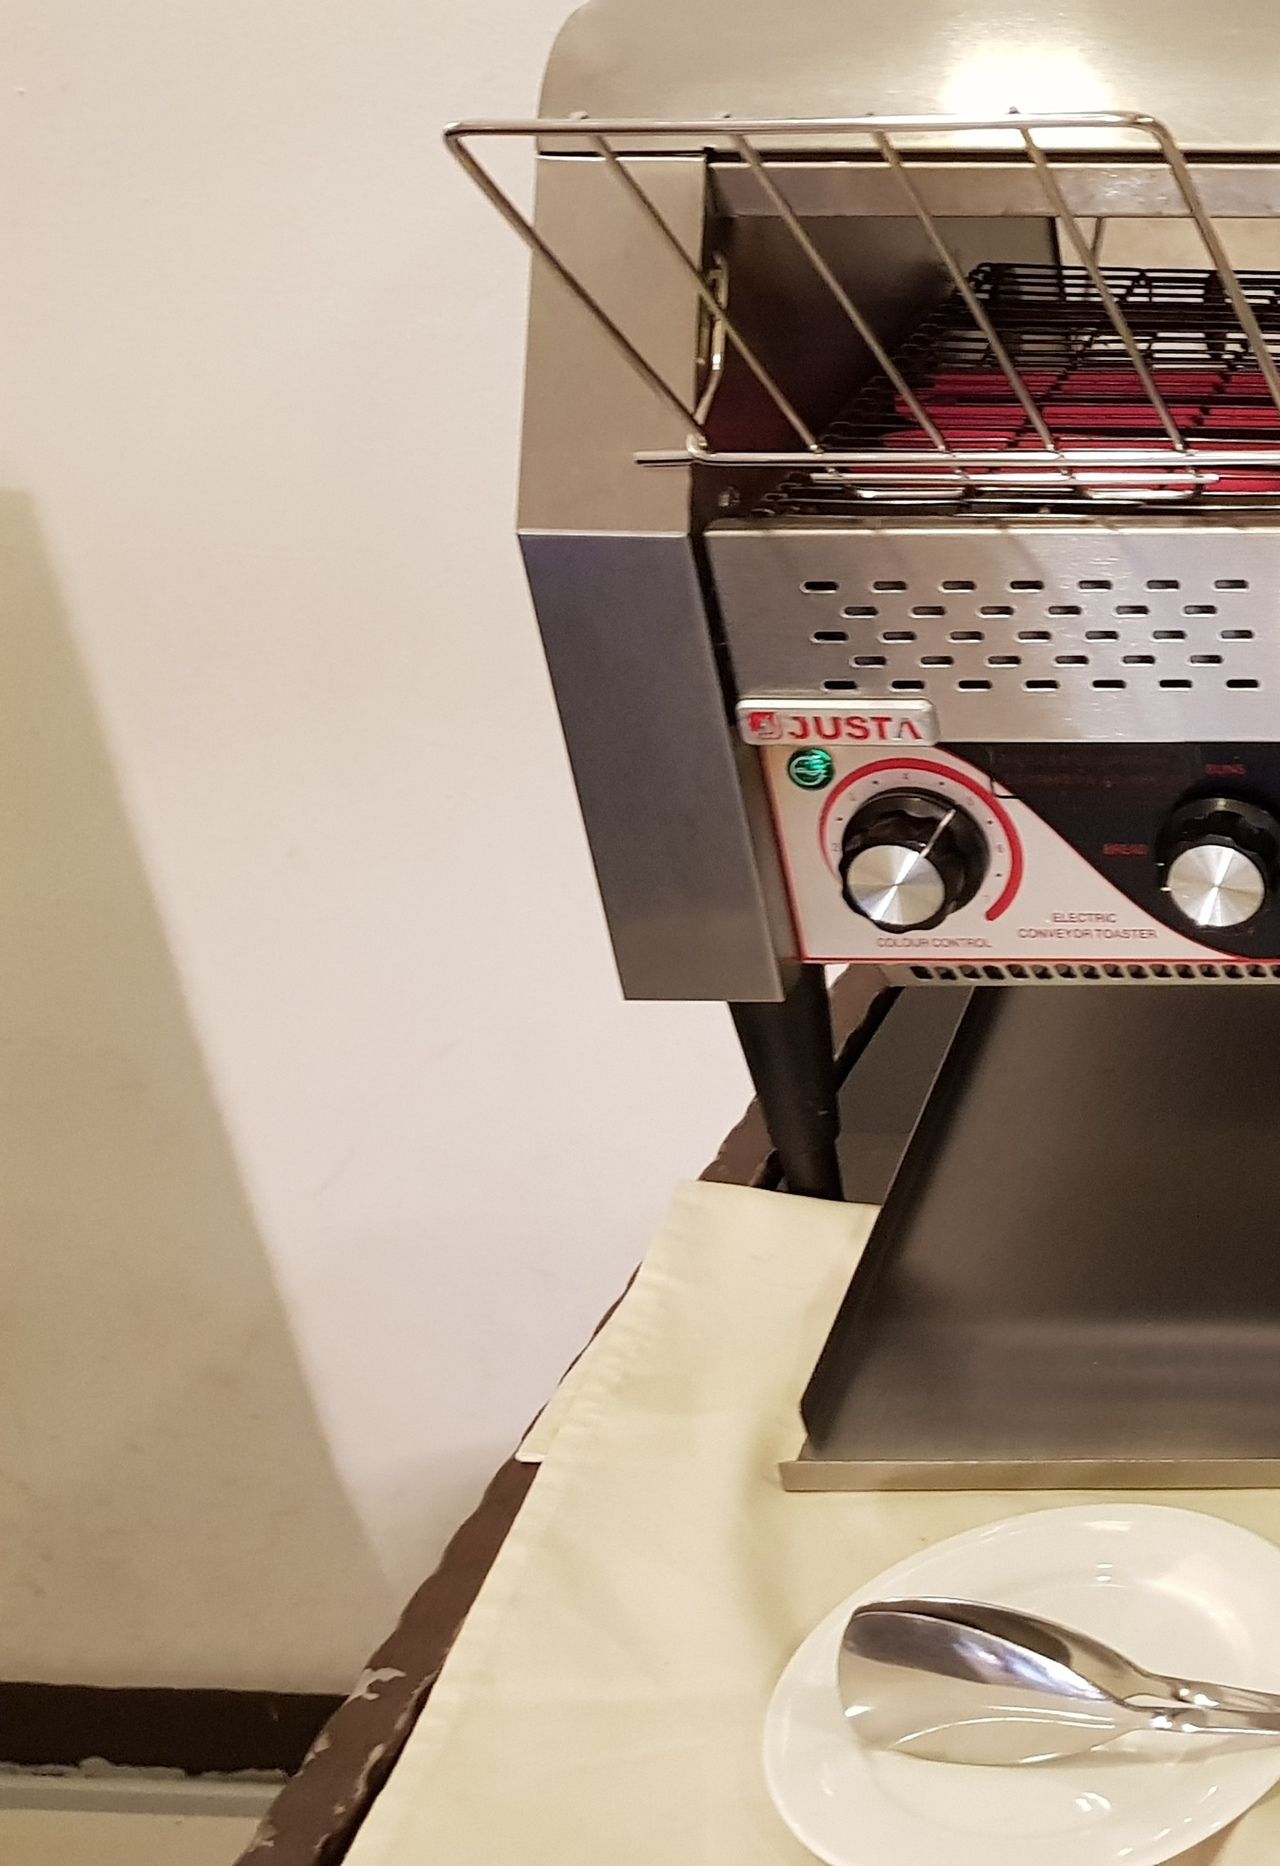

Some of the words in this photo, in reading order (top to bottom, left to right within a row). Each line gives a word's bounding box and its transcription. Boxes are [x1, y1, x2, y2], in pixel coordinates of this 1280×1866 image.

[788, 715, 922, 740] JUSTA
[1053, 912, 1117, 924] ELECTRIC
[1018, 928, 1095, 939] CONVEYOR
[1099, 928, 1158, 939] TOASTER
[876, 937, 929, 948] COLOUR
[932, 937, 993, 949] CONTROL
